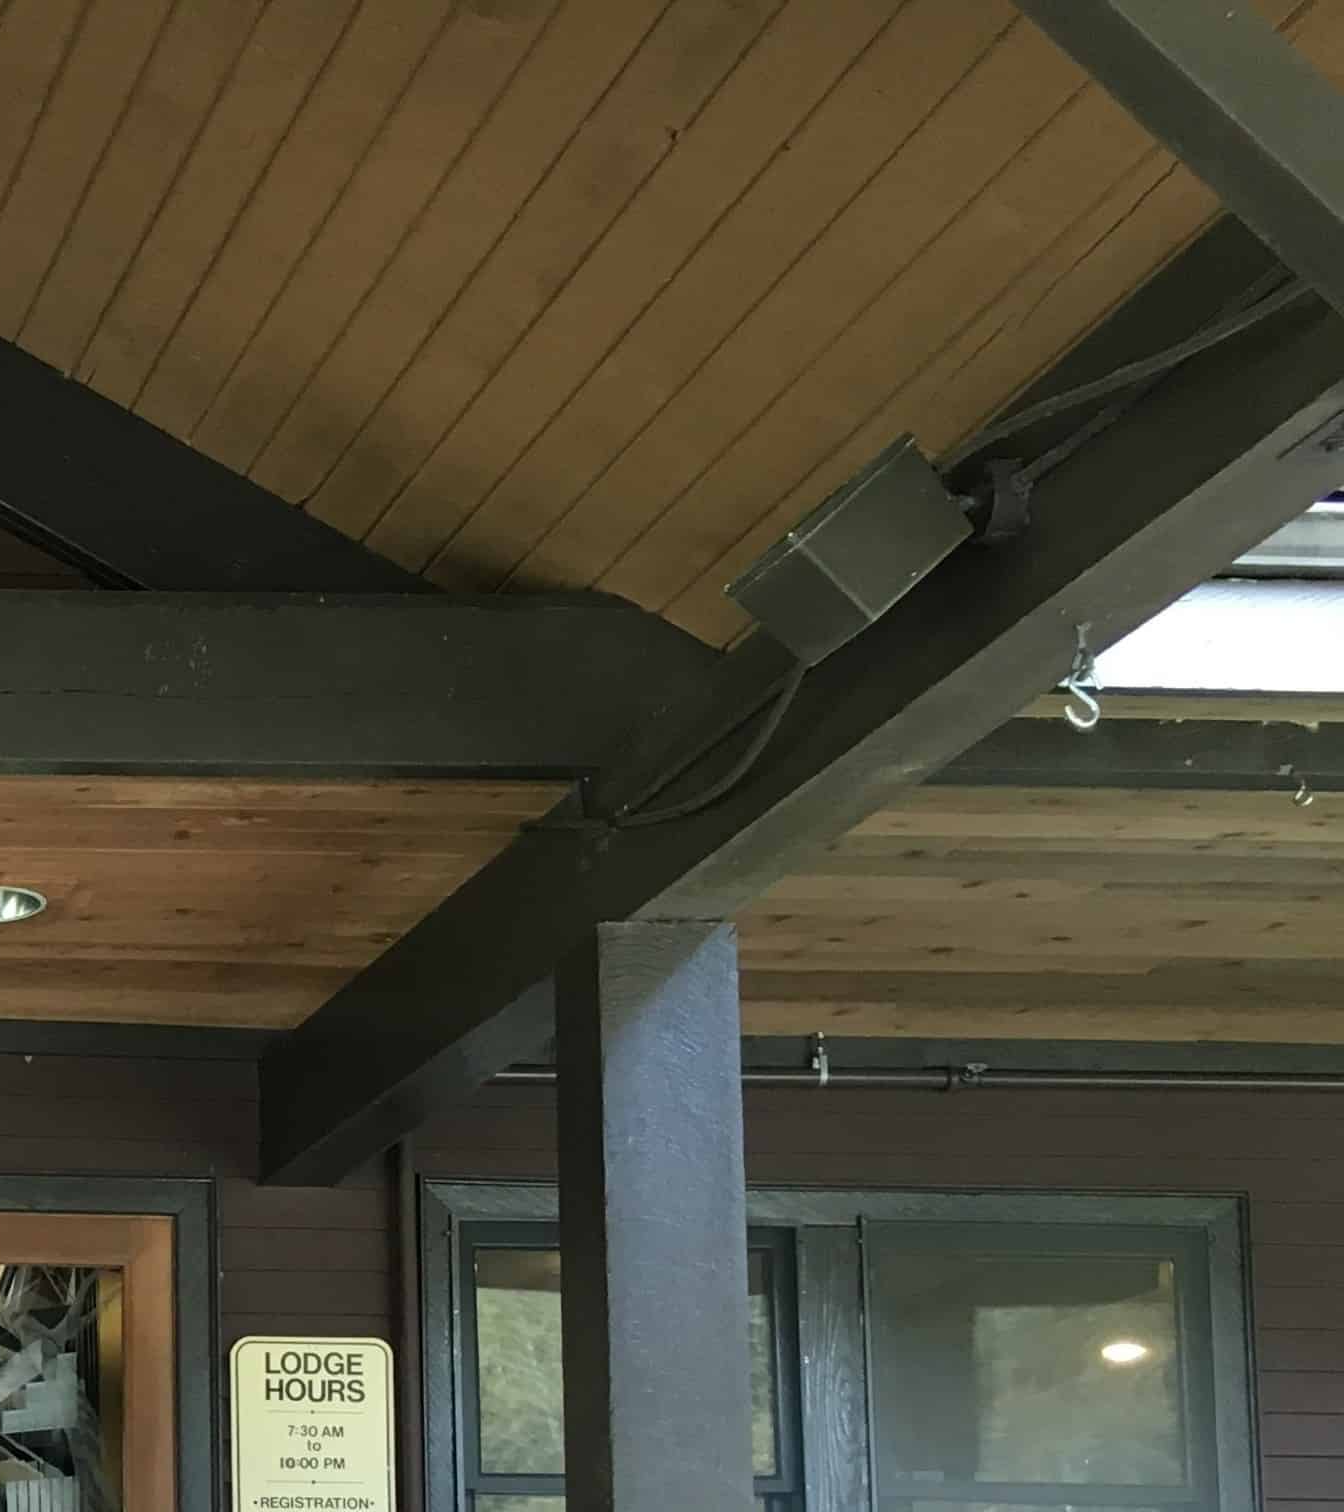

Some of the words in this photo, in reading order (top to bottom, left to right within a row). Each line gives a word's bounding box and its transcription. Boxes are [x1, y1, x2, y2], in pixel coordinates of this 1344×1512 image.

[265, 1352, 363, 1376] LODGE
[265, 1378, 365, 1402] HOURS
[288, 1425, 318, 1437] 7:30
[322, 1426, 344, 1437] AM
[308, 1440, 321, 1451] to
[280, 1457, 318, 1469] 10:00
[324, 1458, 345, 1469] PM
[261, 1497, 368, 1509] REGISTRATION
